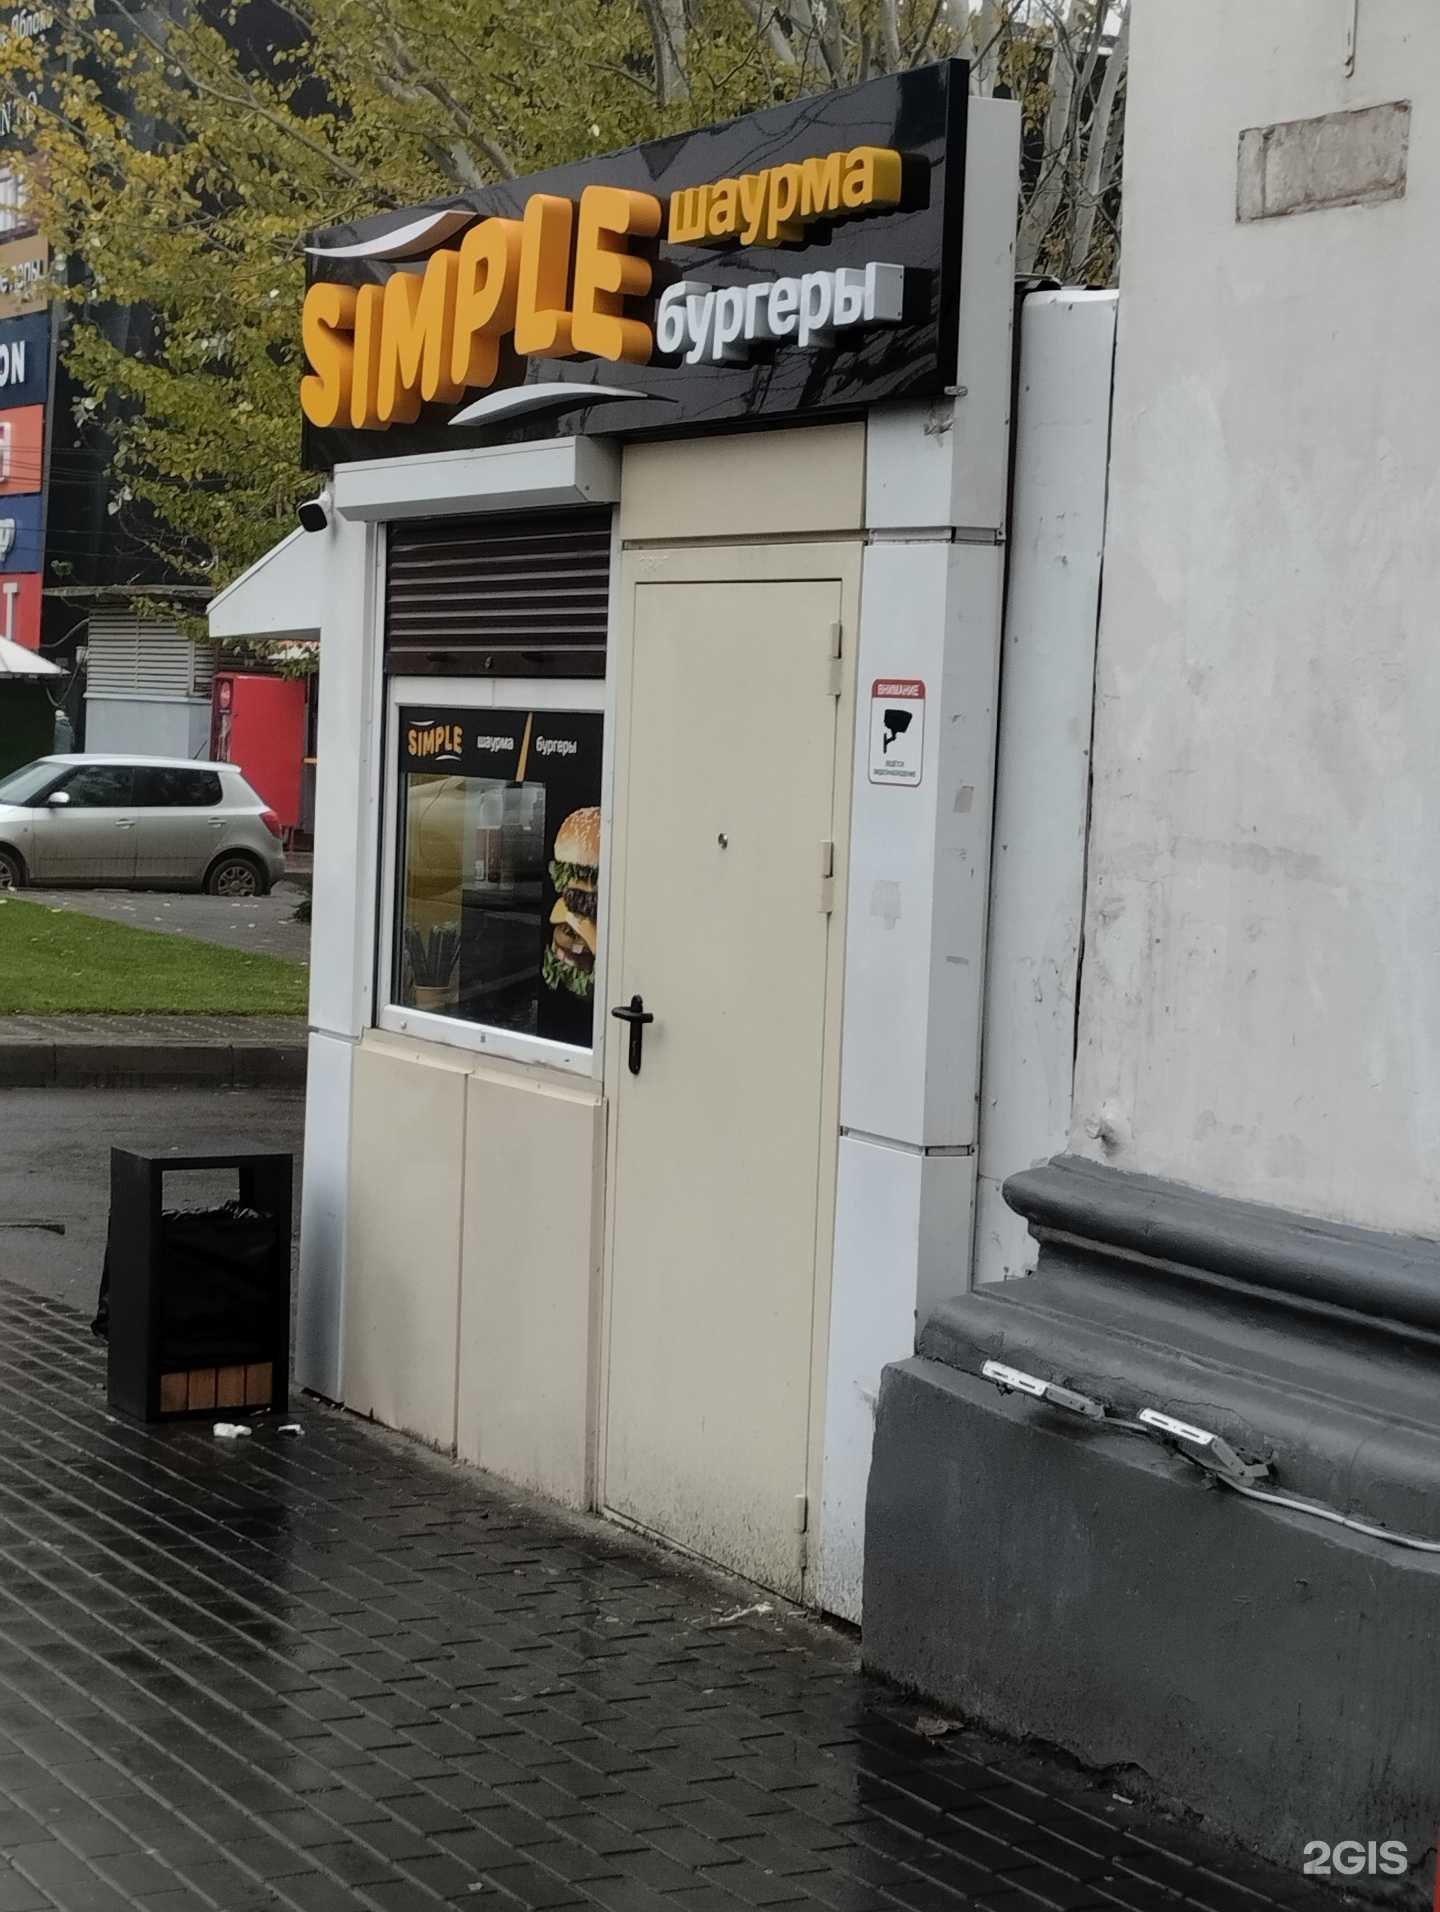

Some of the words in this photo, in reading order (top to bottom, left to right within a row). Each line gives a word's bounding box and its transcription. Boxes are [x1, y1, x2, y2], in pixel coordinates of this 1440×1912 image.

[668, 146, 902, 248] шаурма
[300, 185, 662, 430] SIMPLE
[656, 262, 905, 365] бургеры
[408, 726, 463, 757] SIMPLE
[477, 735, 514, 752] шаурма
[536, 736, 577, 755] бургеры
